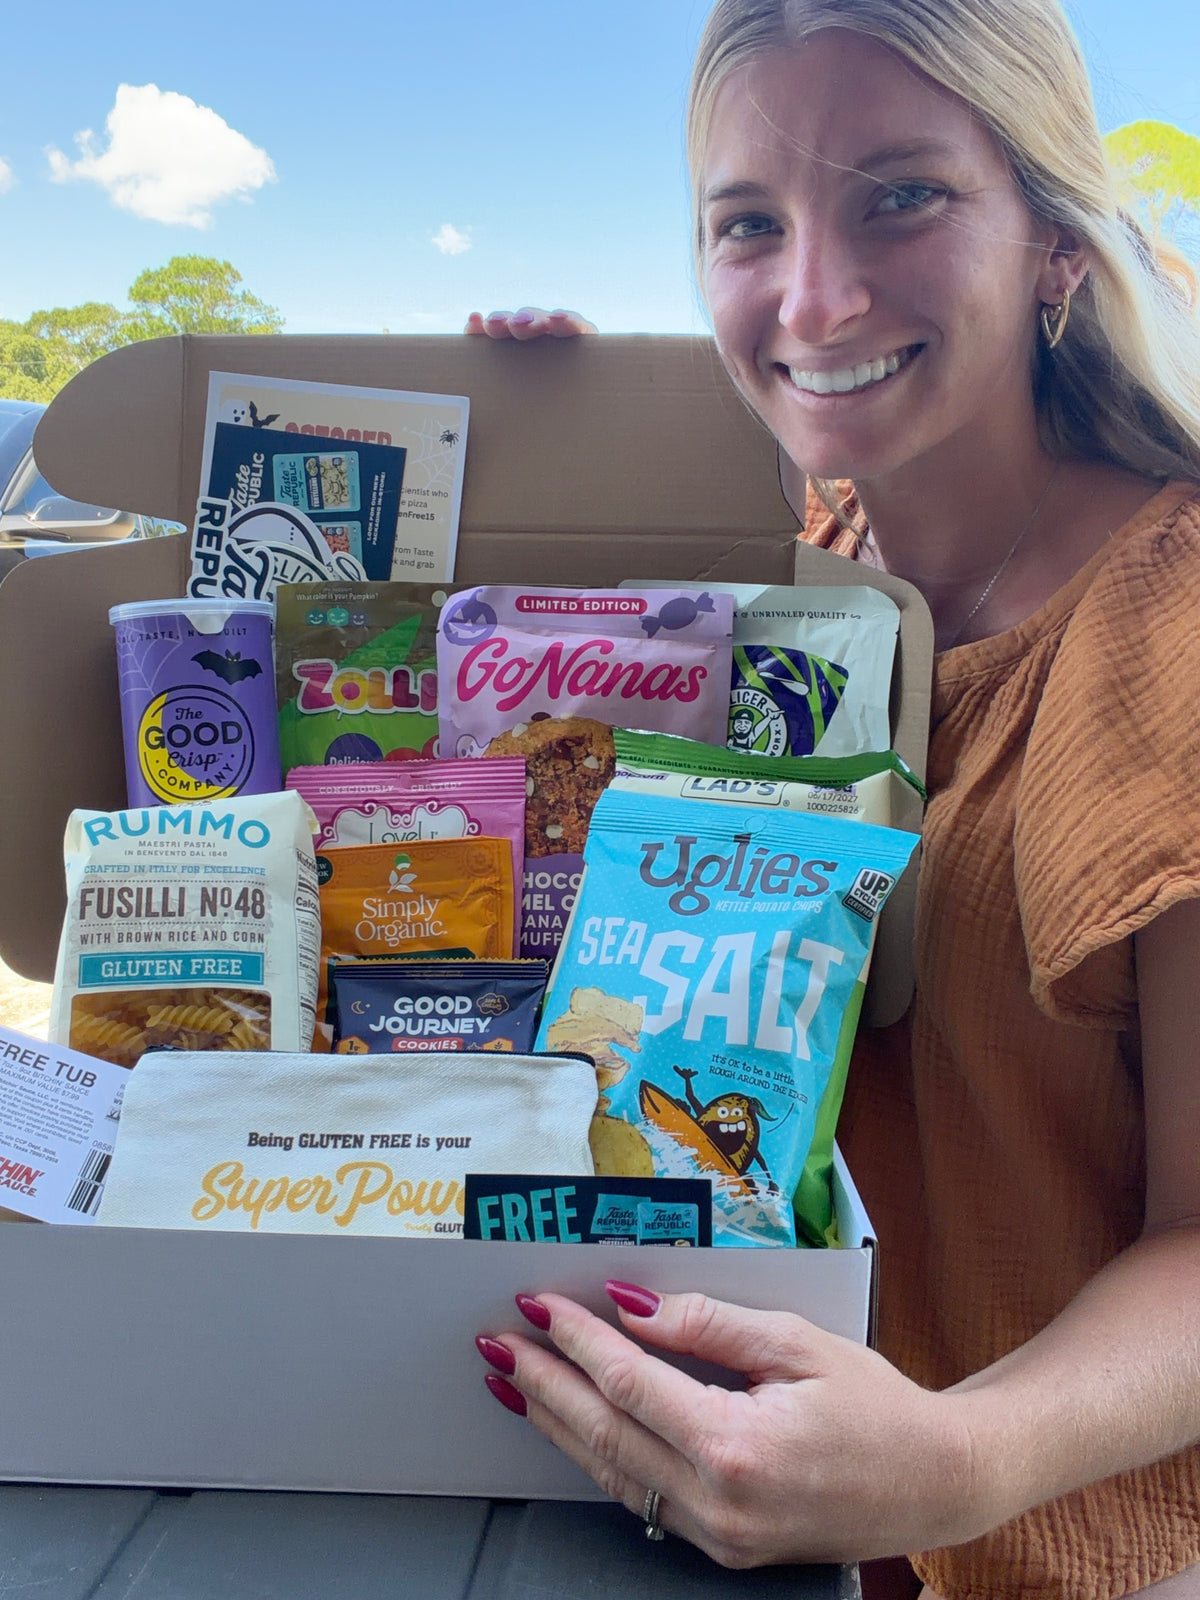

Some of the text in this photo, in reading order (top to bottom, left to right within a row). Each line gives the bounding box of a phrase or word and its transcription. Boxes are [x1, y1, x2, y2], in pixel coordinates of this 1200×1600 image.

[247, 452, 265, 507] PUBLIC
[431, 489, 449, 498] who
[407, 500, 428, 509] pizza
[191, 502, 227, 598] REPU
[414, 547, 434, 557] Taste
[416, 559, 435, 569] grab
[523, 599, 640, 612] LIMITED EDITION
[752, 610, 847, 619] UNRIVALED QUALITY
[456, 637, 708, 713] GoNanas
[296, 661, 438, 712] ZOLLI
[731, 690, 768, 710] LICER
[175, 707, 204, 720] The
[144, 721, 243, 750] GOOD
[167, 751, 219, 772] Crisp
[158, 763, 234, 791] COMPANY
[806, 802, 859, 814] 1000225826
[83, 809, 271, 849] RUMMO
[138, 840, 216, 849] MAESTRI PASTAI
[84, 864, 266, 876] CRAFTED IN ITALY FOR EXCELLENCE
[639, 832, 838, 916] Uglies
[860, 870, 889, 897] UP
[79, 886, 186, 920] FUSILLI
[362, 894, 441, 922] Simply
[715, 900, 823, 914] KETTLE POTATO CHIPS
[80, 930, 265, 945] WITH BROWN RICE AND CORN
[355, 919, 444, 947] Organic
[520, 932, 563, 947] MUFF
[101, 958, 242, 978] GLUTEN FREE
[577, 916, 845, 1061] SEA SALT
[393, 995, 472, 1015] GOOD
[368, 1015, 493, 1036] JOURNEY
[397, 1039, 458, 1051] COOKIES
[55, 1060, 97, 1088] TUB
[753, 1065, 763, 1076] be
[36, 1081, 60, 1094] VALUE
[64, 1082, 89, 1096] SAUCE
[709, 1066, 736, 1080] ROUGH
[737, 1072, 771, 1090] AROUND
[772, 1083, 788, 1095] THE
[247, 1132, 472, 1151] Being GLUTEN FREE is your
[191, 1160, 464, 1230] Super Pow
[477, 1185, 582, 1244] FREE
[606, 1206, 635, 1219] Taste
[653, 1208, 682, 1222] Taste
[434, 1222, 464, 1233] GLUT
[644, 1221, 691, 1230] REPUBLIC
